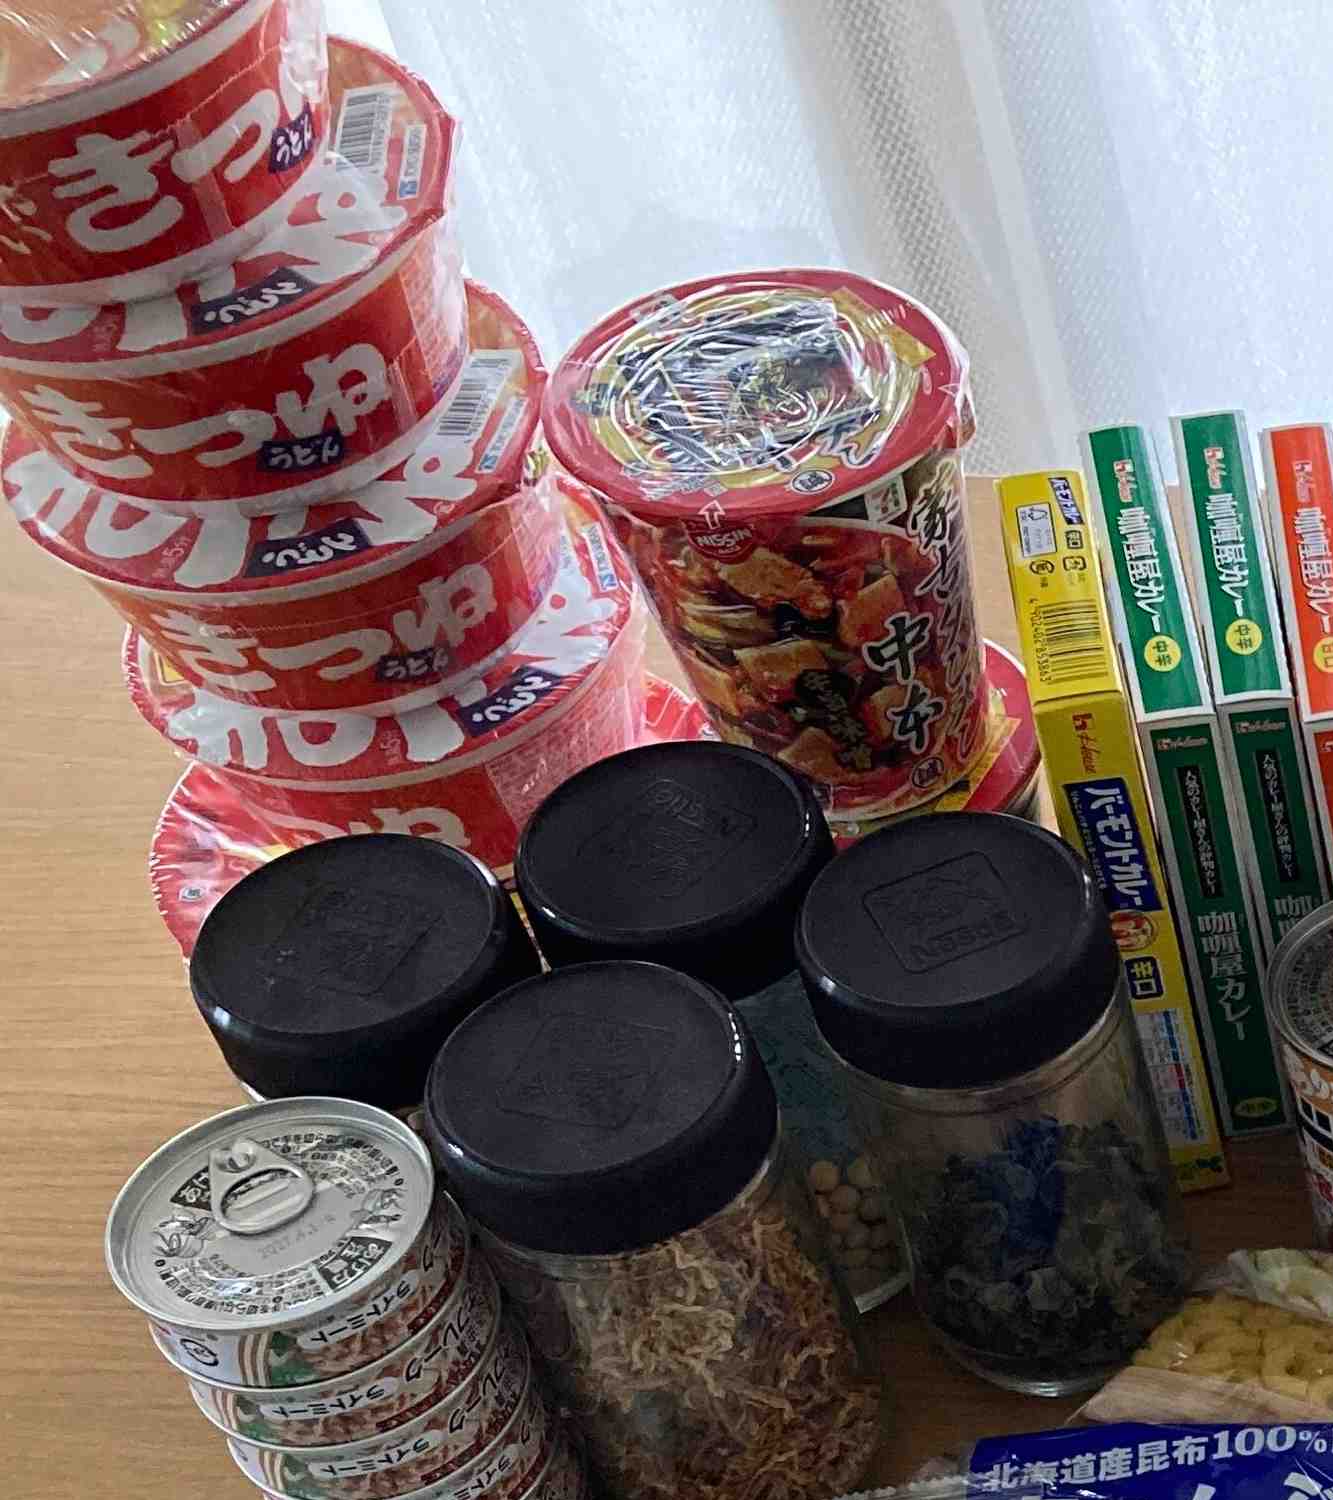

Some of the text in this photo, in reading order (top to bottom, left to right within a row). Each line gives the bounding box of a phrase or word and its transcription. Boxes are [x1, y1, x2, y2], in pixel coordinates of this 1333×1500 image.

[20, 342, 390, 480] きつね
[268, 437, 344, 472] うどん
[158, 562, 496, 692] きつね
[1084, 784, 1146, 912] バーモントカレー
[1130, 959, 1160, 997] 辛口
